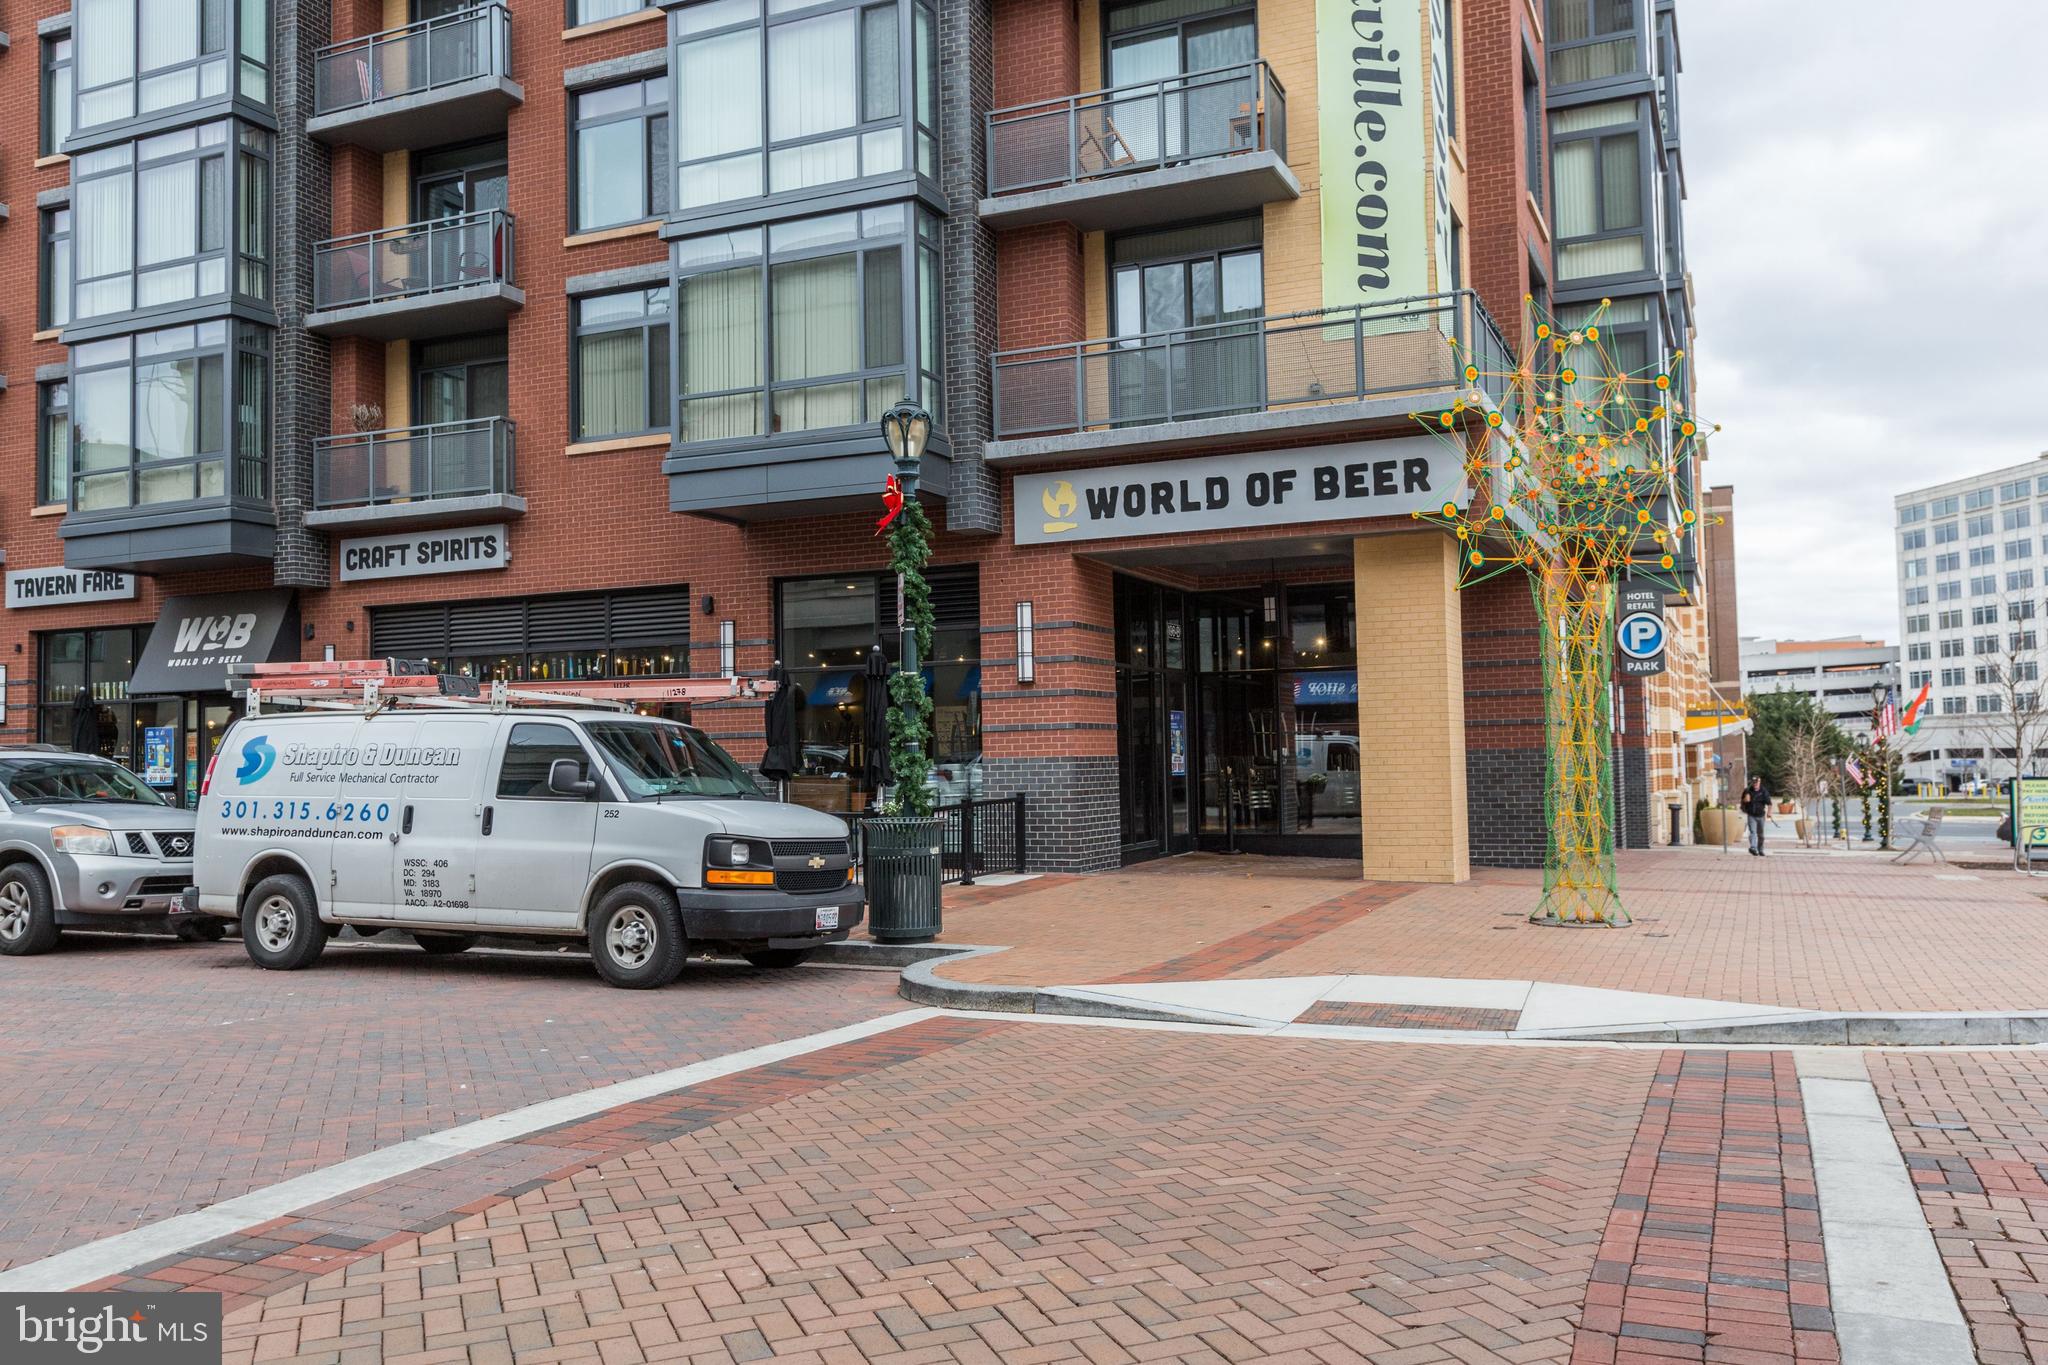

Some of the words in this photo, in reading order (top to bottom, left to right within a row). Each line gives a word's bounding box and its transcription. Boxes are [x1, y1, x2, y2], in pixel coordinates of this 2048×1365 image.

[1085, 476, 1229, 520] WORLD
[1246, 470, 1297, 507] OF
[1313, 457, 1432, 502] BEER
[346, 543, 411, 571] CRAFT
[416, 535, 497, 564] SPIRITS
[14, 574, 77, 598] TAVERN
[83, 571, 125, 593] FARE
[1626, 592, 1655, 600] HOTEL
[1626, 602, 1656, 610] RETAIL
[1630, 621, 1657, 650] P
[167, 658, 199, 667] WORLD
[202, 656, 215, 665] OF
[218, 655, 243, 663] BEER
[1627, 661, 1659, 671] PARK
[282, 742, 359, 770] Shapiro
[379, 743, 461, 767] Duncan
[289, 772, 304, 783] Full
[306, 772, 336, 783] Service
[338, 772, 387, 784] Mechanical
[389, 773, 440, 784] Contractor
[221, 800, 390, 821] 301.315.6260
[604, 809, 620, 818] 252
[221, 826, 383, 840] www.shapiroandduncan.com
[403, 859, 428, 867] WSSC:
[433, 859, 449, 868] 406
[403, 869, 416, 877] DC:
[421, 869, 436, 877] 294
[403, 879, 417, 887] MD:
[422, 879, 440, 888] 3183
[404, 889, 416, 897] VA:
[420, 889, 442, 898] 18970
[404, 899, 428, 907] AACO:
[433, 900, 469, 909] A2-01698
